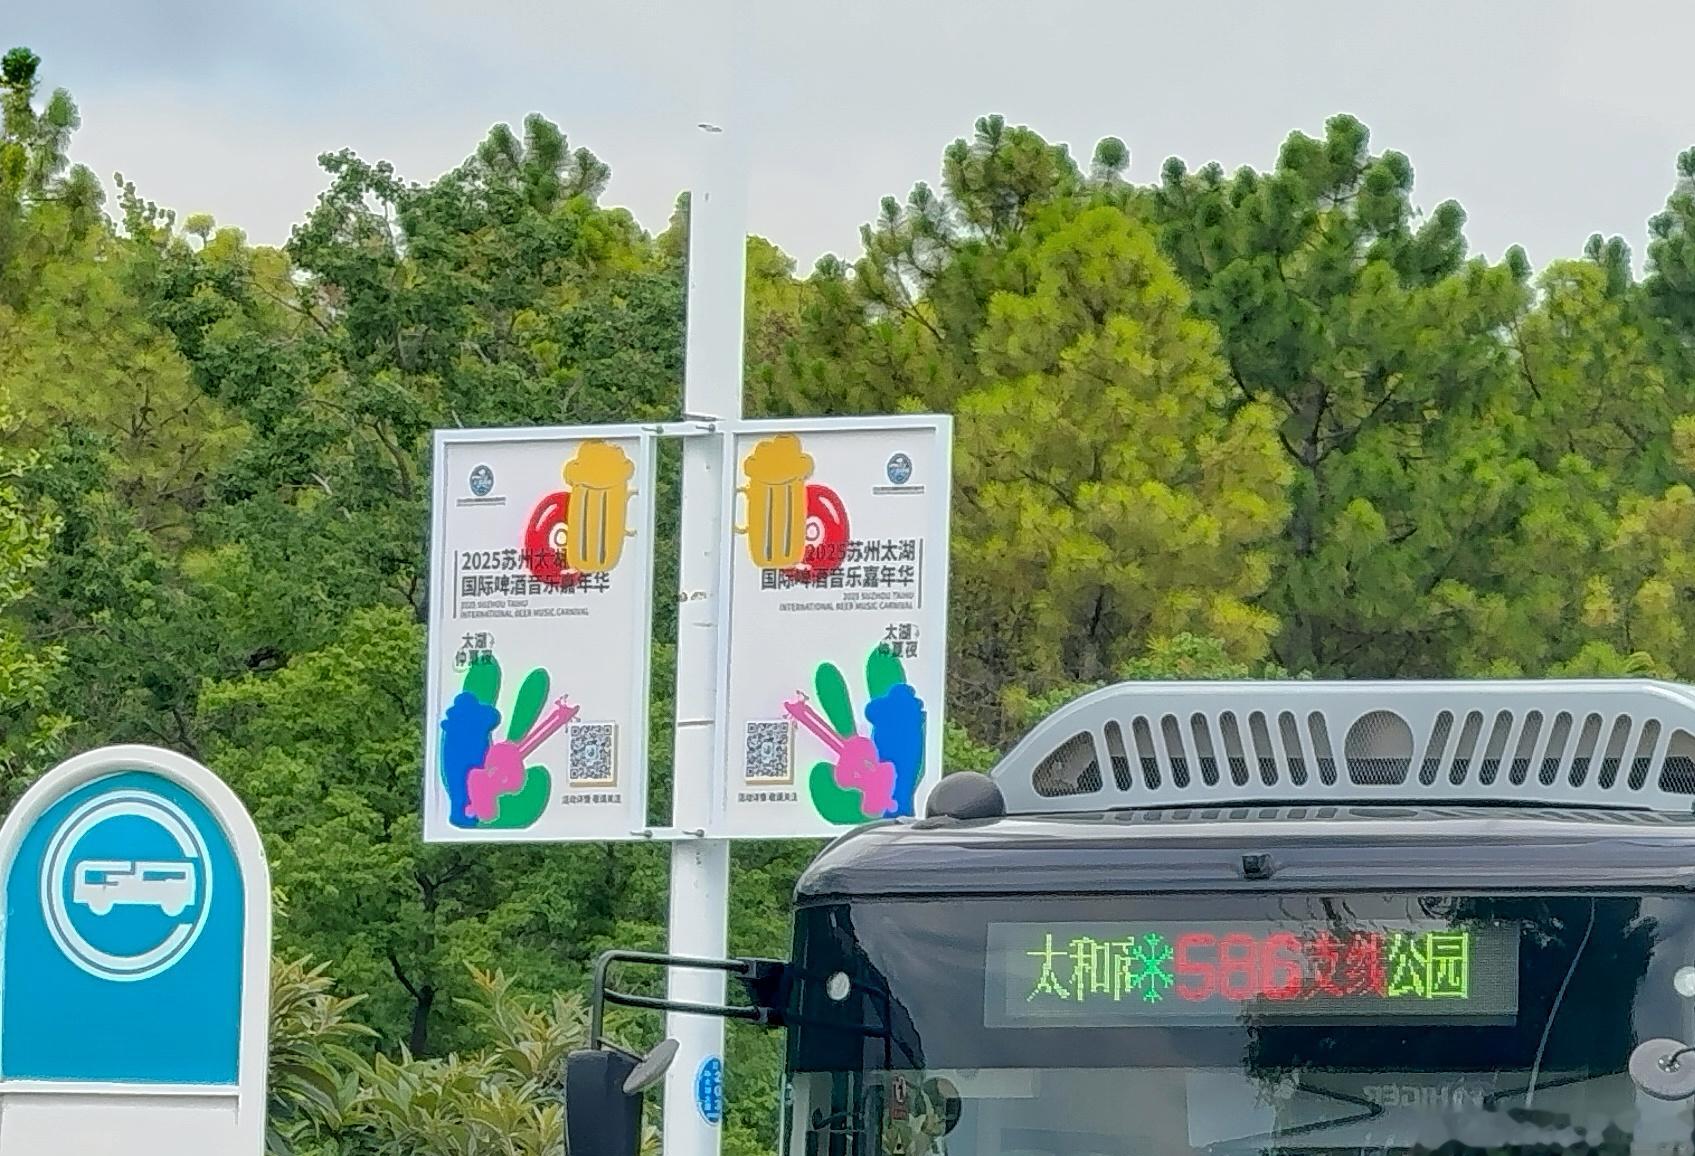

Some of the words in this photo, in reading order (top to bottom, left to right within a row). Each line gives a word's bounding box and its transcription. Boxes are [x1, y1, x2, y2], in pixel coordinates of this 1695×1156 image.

[805, 539, 915, 562] 2025苏州太湖
[461, 571, 610, 597] 国际啤酒音乐嘉年华
[761, 564, 914, 590] 国际啤酒音乐嘉年华
